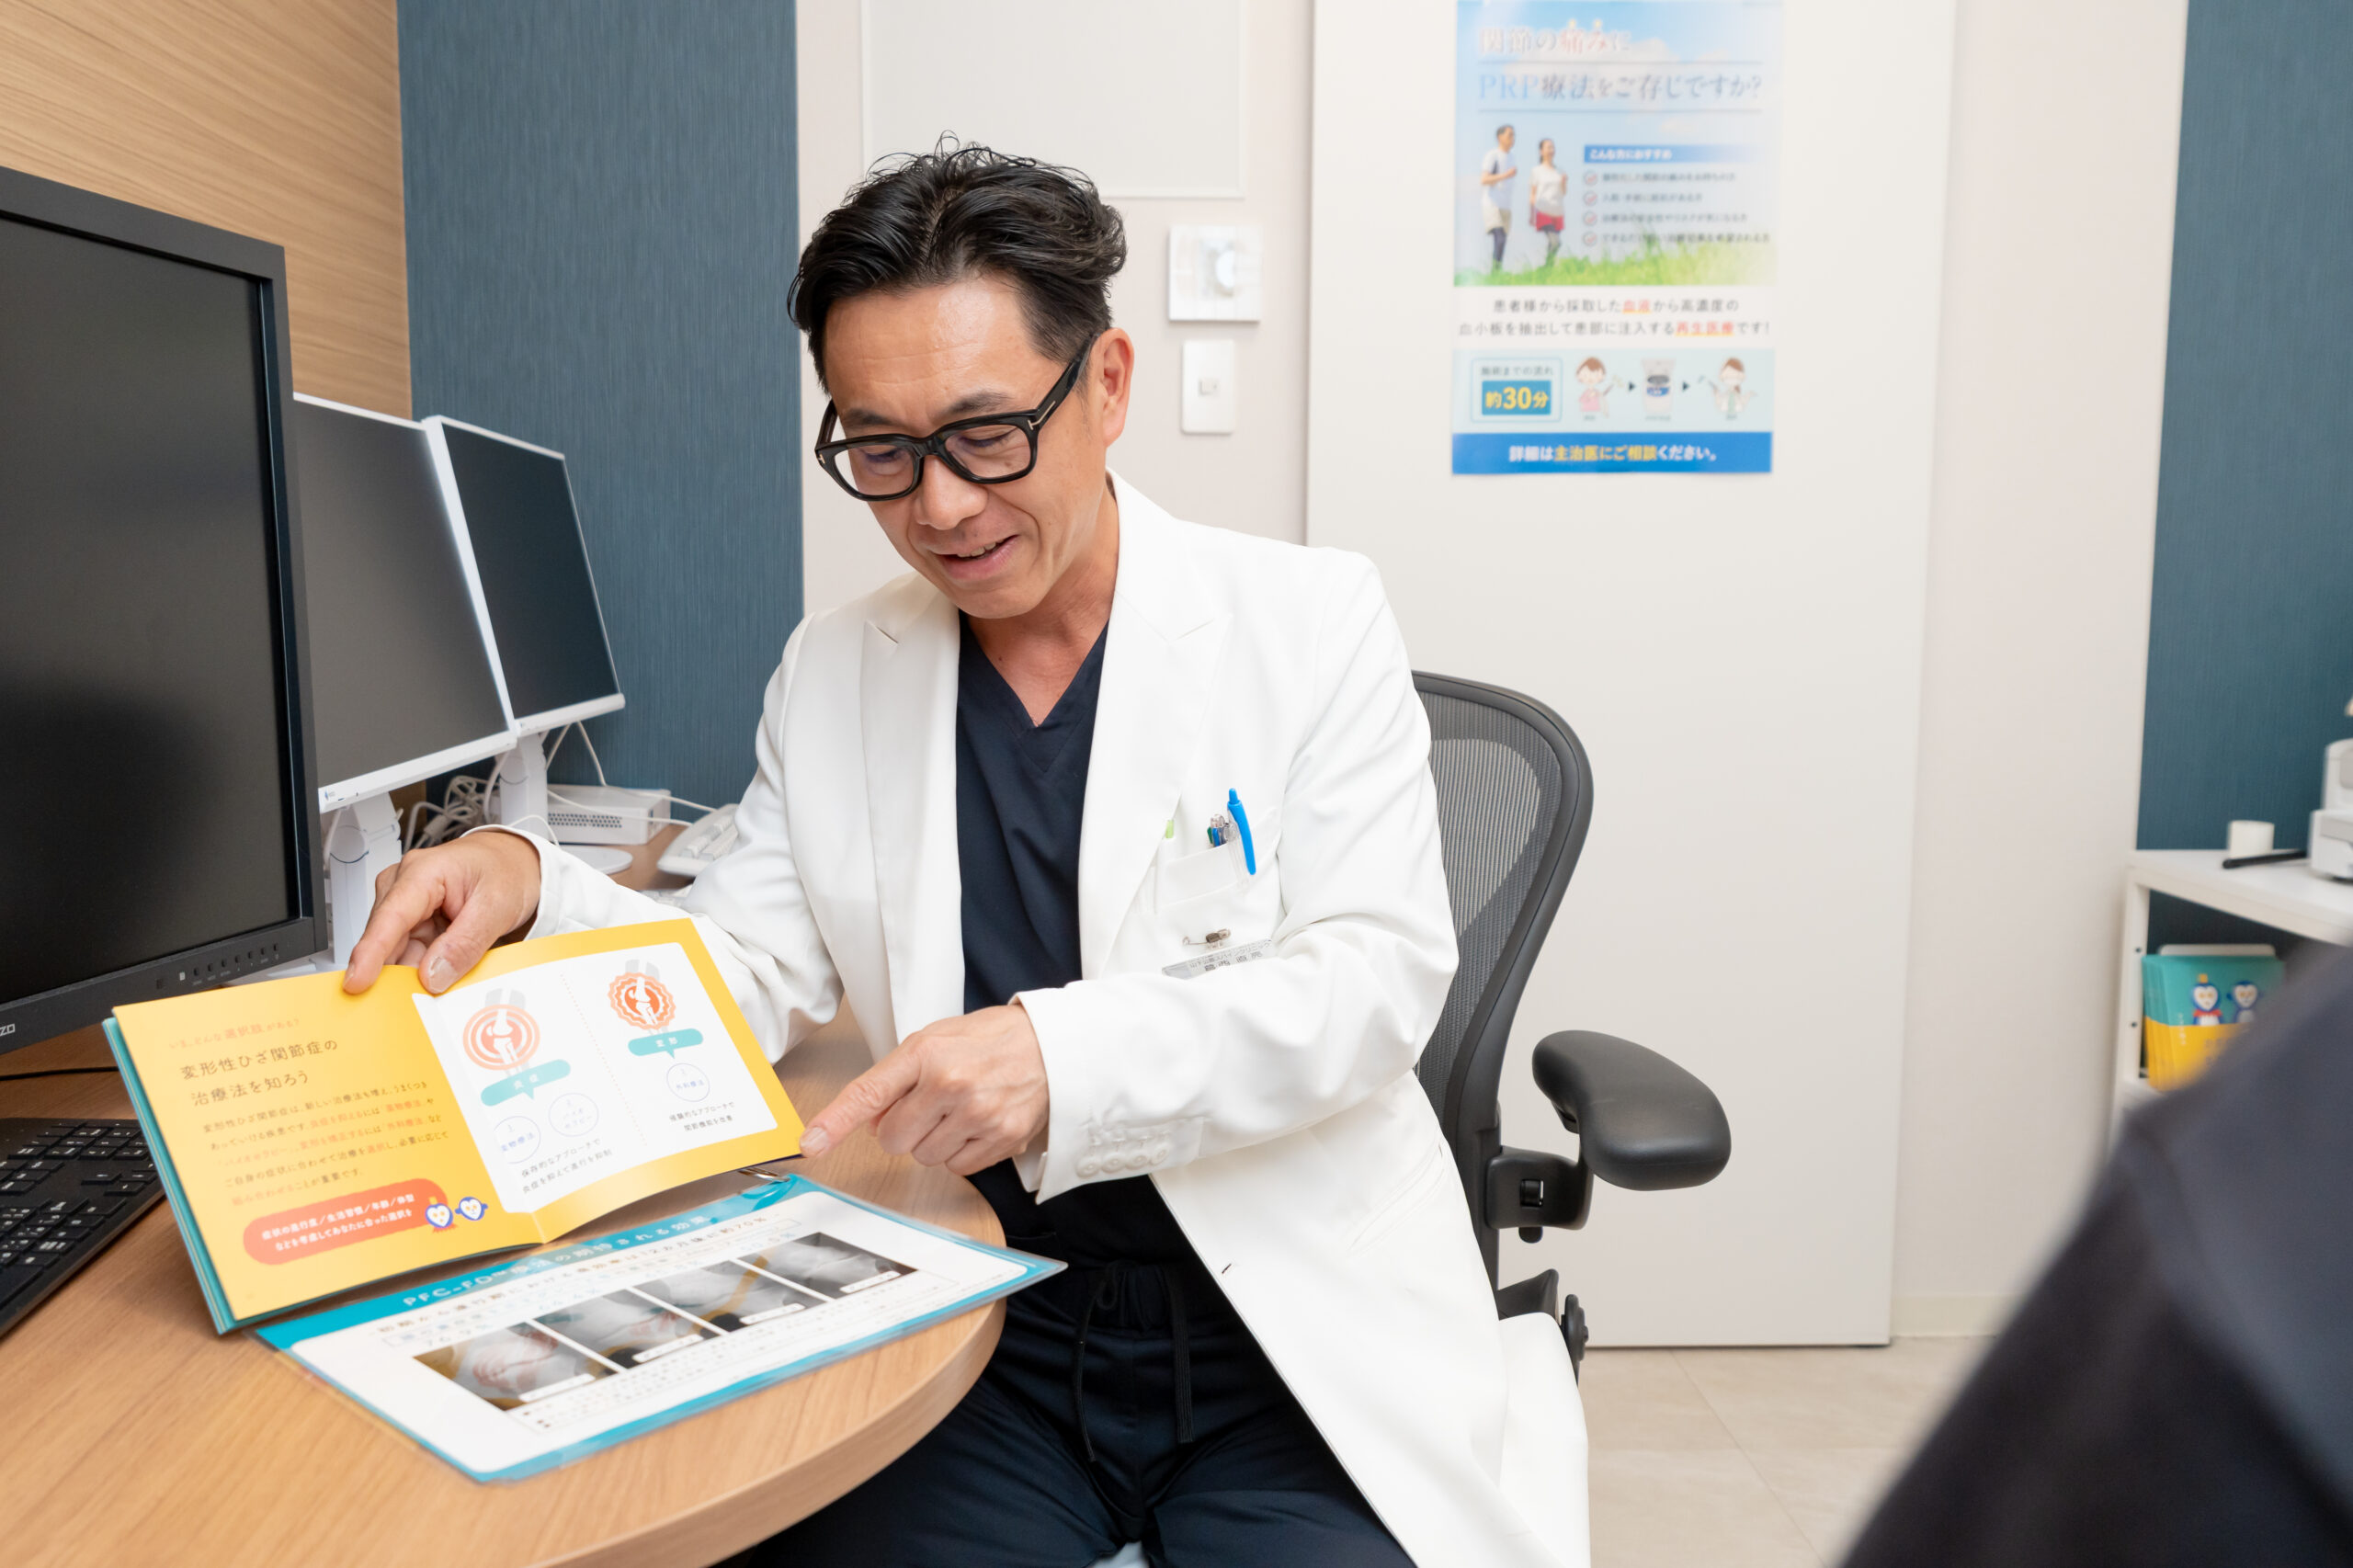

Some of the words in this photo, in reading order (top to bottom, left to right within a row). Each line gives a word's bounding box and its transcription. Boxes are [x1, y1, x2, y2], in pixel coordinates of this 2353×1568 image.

[1485, 387, 1549, 411] 約30分
[179, 1039, 338, 1081] 変形性ひざ関節症の
[190, 1069, 309, 1107] 治療法を知ろう
